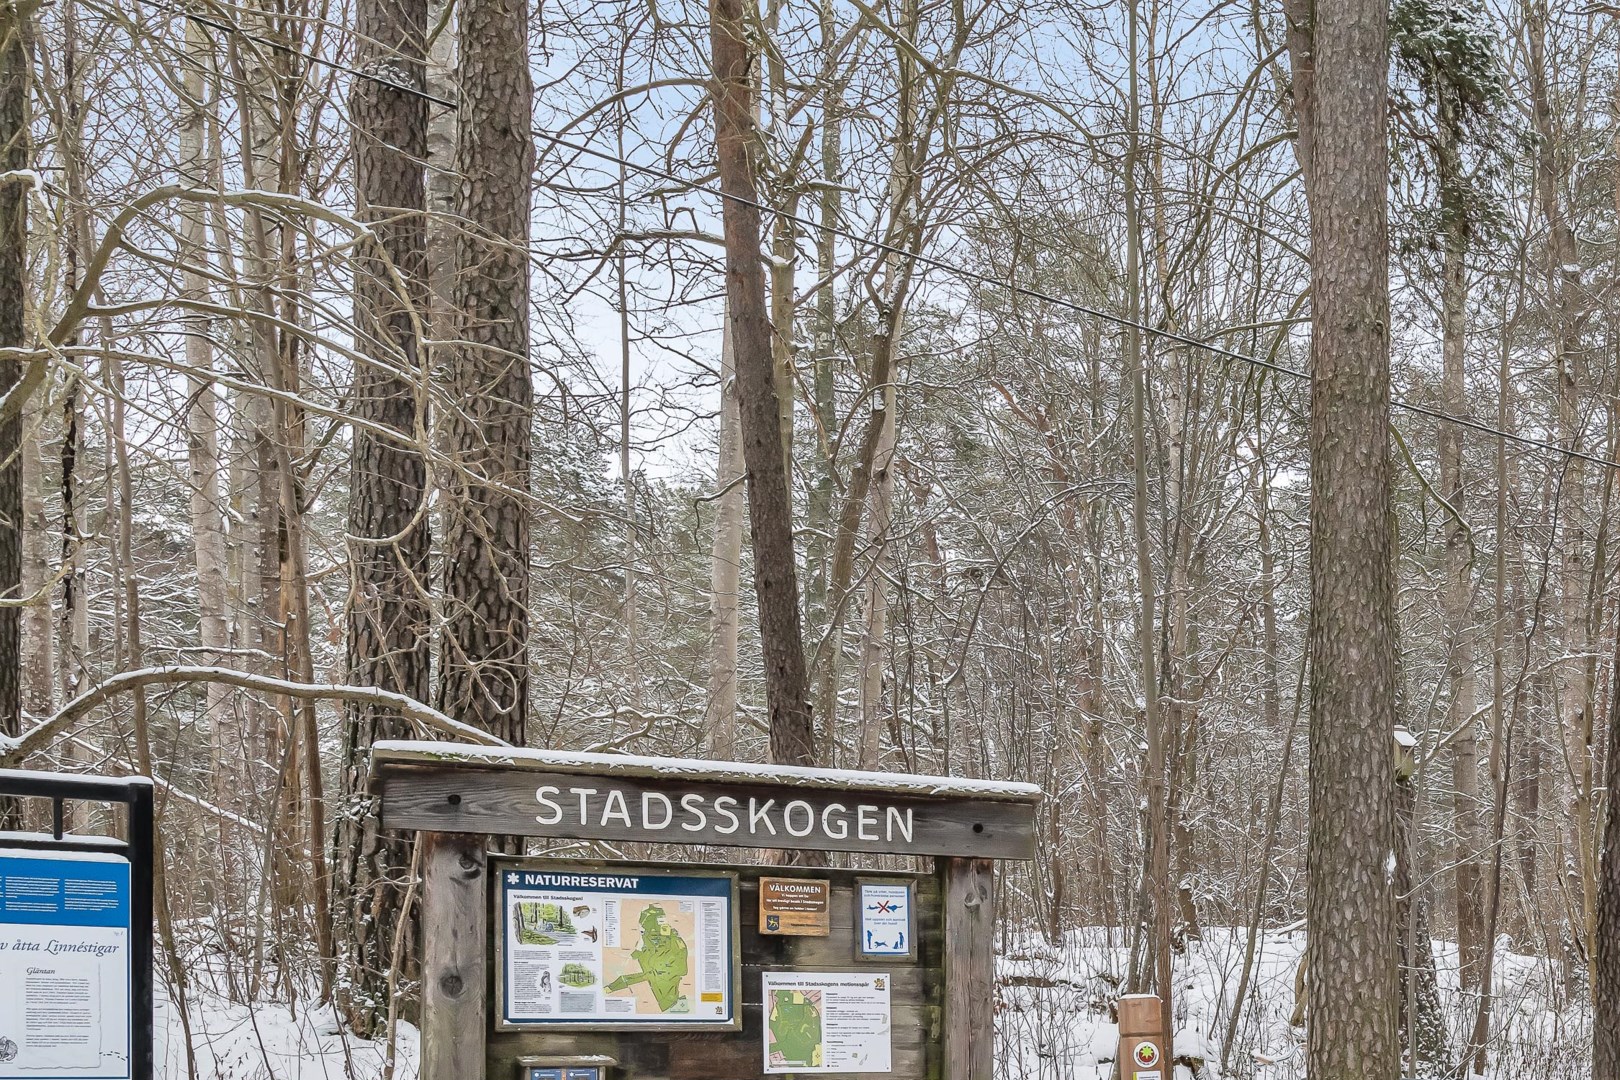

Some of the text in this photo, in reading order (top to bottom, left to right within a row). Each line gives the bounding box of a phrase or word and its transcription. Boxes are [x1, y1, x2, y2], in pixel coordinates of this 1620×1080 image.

[534, 785, 914, 843] STADSSKOGEN
[524, 873, 640, 889] NATURRESERVAT
[769, 882, 821, 894] VÄLKOMMEN
[0, 938, 120, 958] v åtta Linnéstigar
[26, 966, 56, 976] Gläntan
